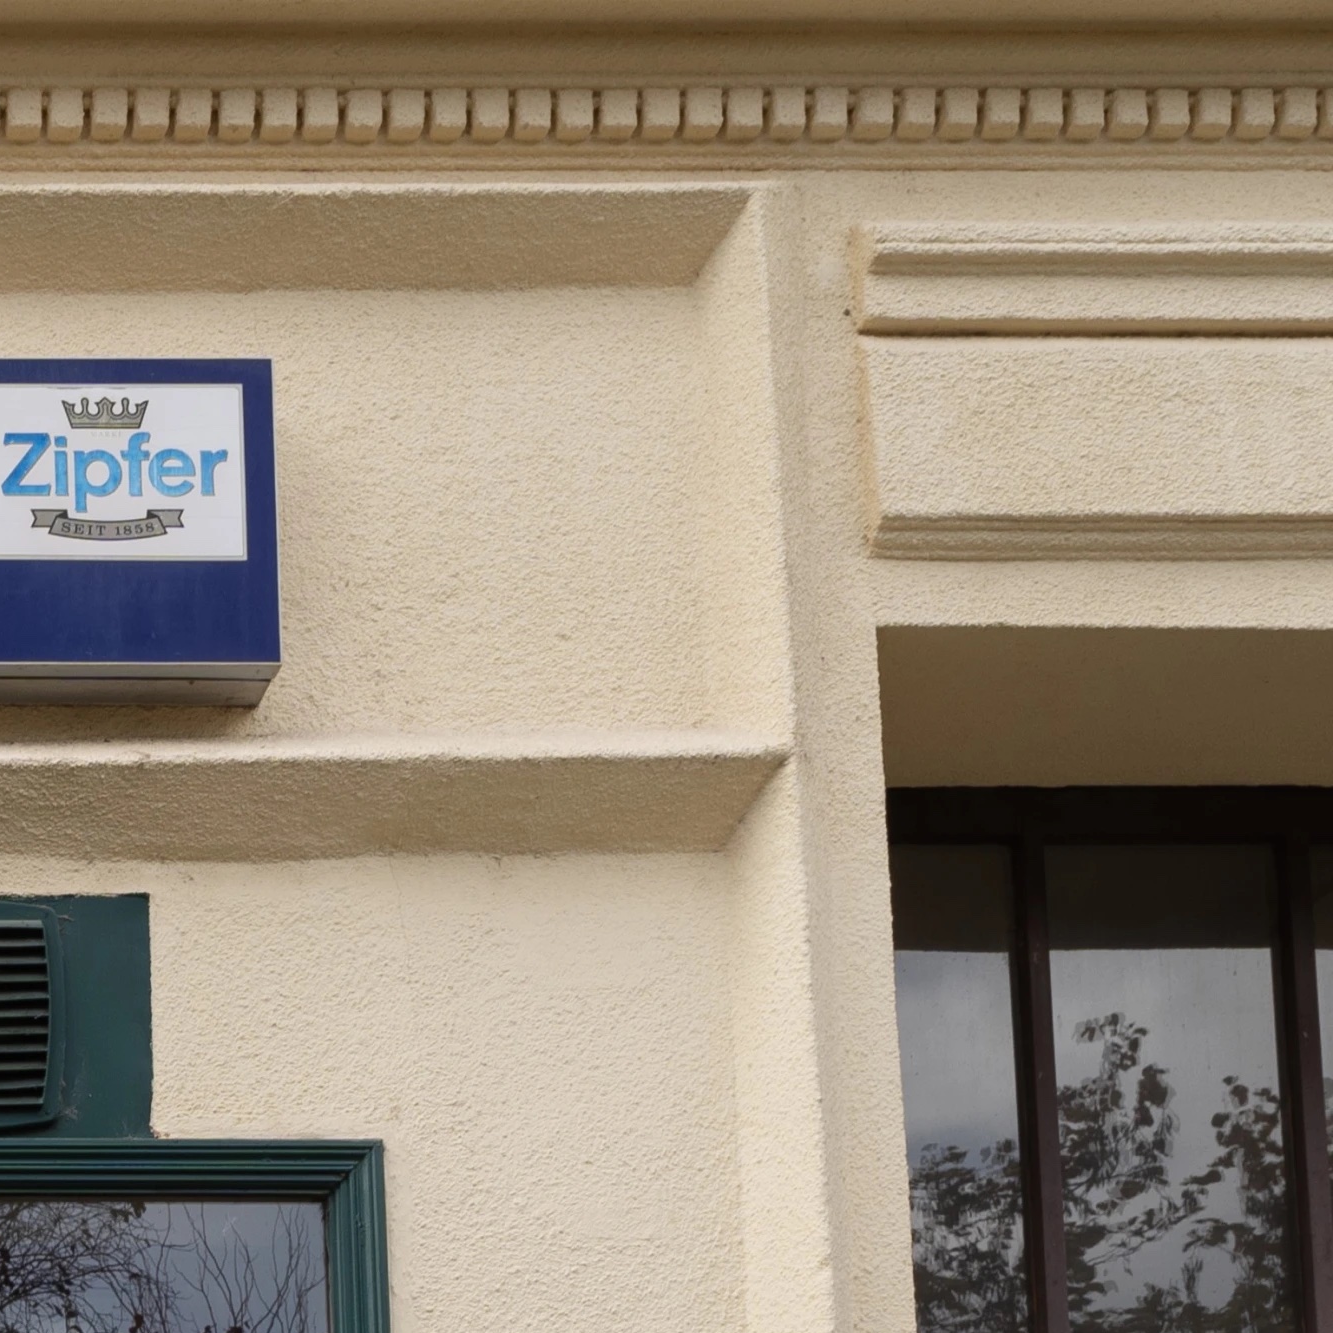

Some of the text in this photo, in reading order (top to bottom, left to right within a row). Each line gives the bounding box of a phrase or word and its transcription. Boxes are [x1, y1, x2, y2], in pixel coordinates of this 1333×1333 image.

[0, 431, 229, 514] Zipfer
[60, 521, 157, 536] SEIT 1858
